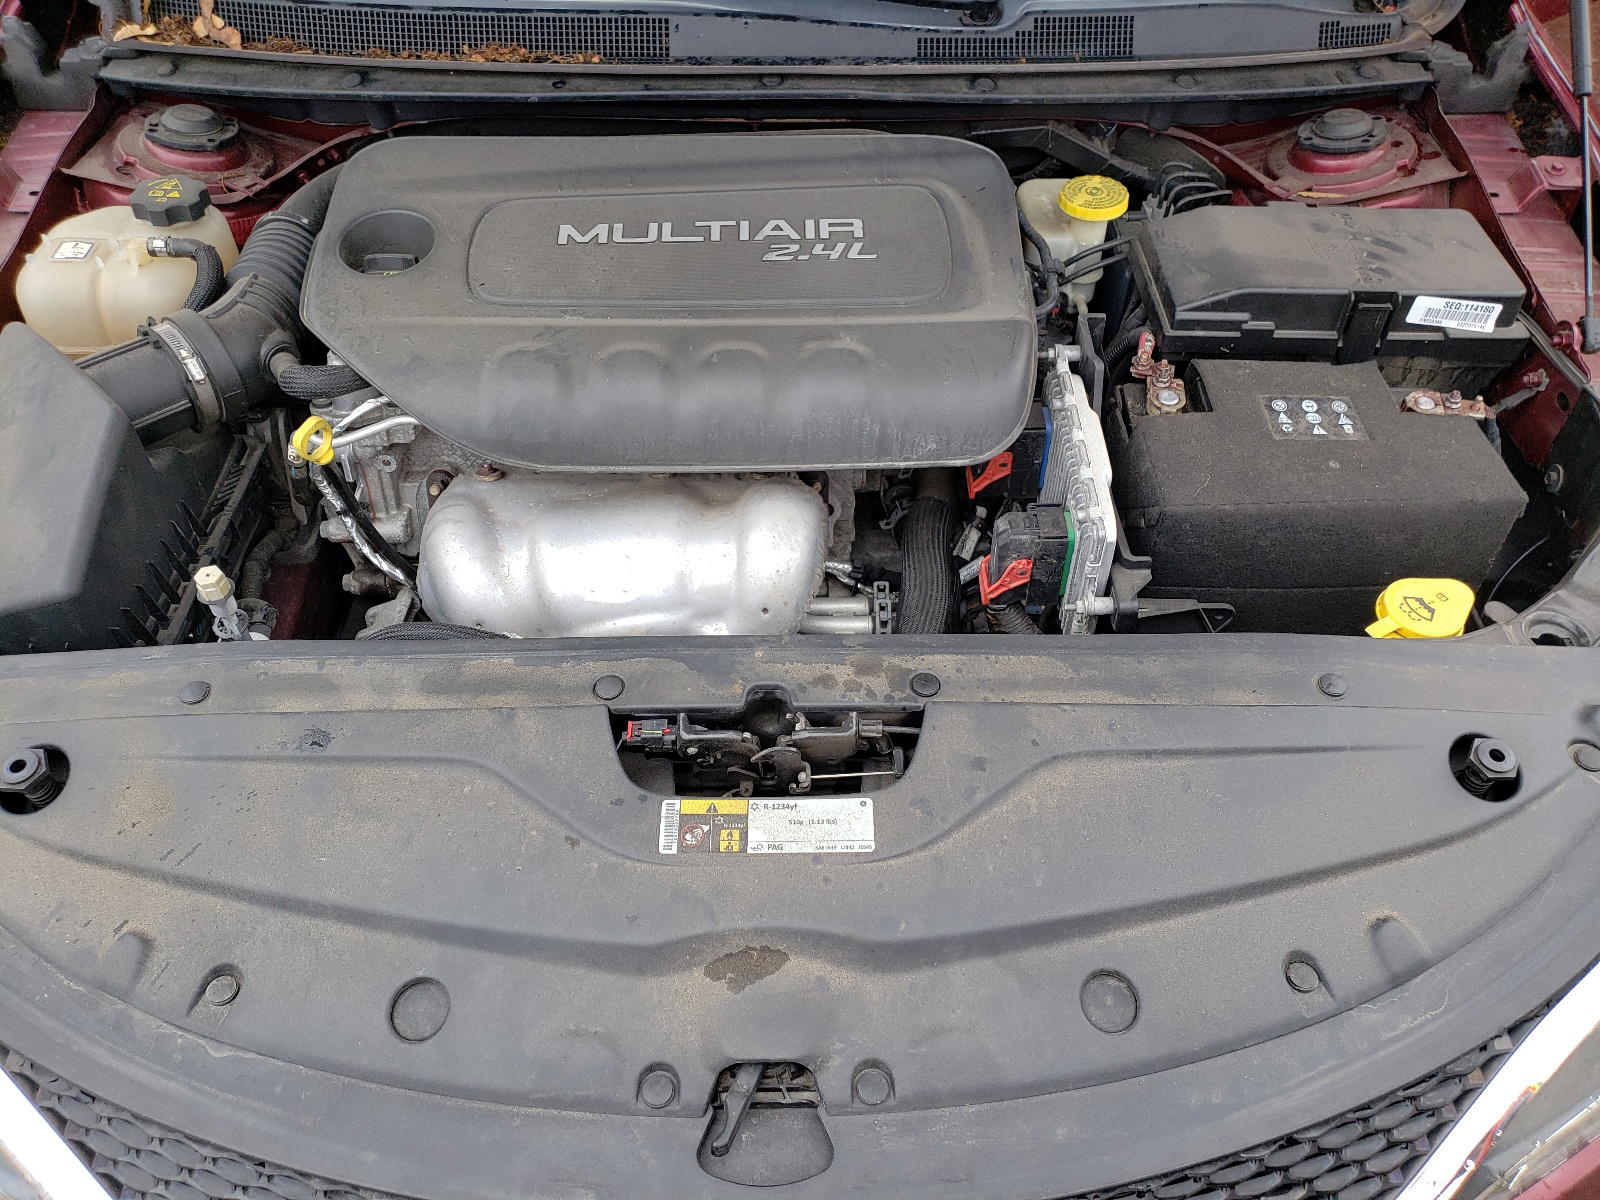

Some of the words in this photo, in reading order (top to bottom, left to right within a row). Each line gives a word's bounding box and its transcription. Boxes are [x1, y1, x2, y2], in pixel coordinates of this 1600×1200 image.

[557, 218, 865, 246] MULTIAIR
[762, 242, 878, 262] 2.4L
[1443, 301, 1495, 314] SEQ:114180
[763, 802, 798, 811] R-1234yf
[767, 843, 784, 851] PAG
